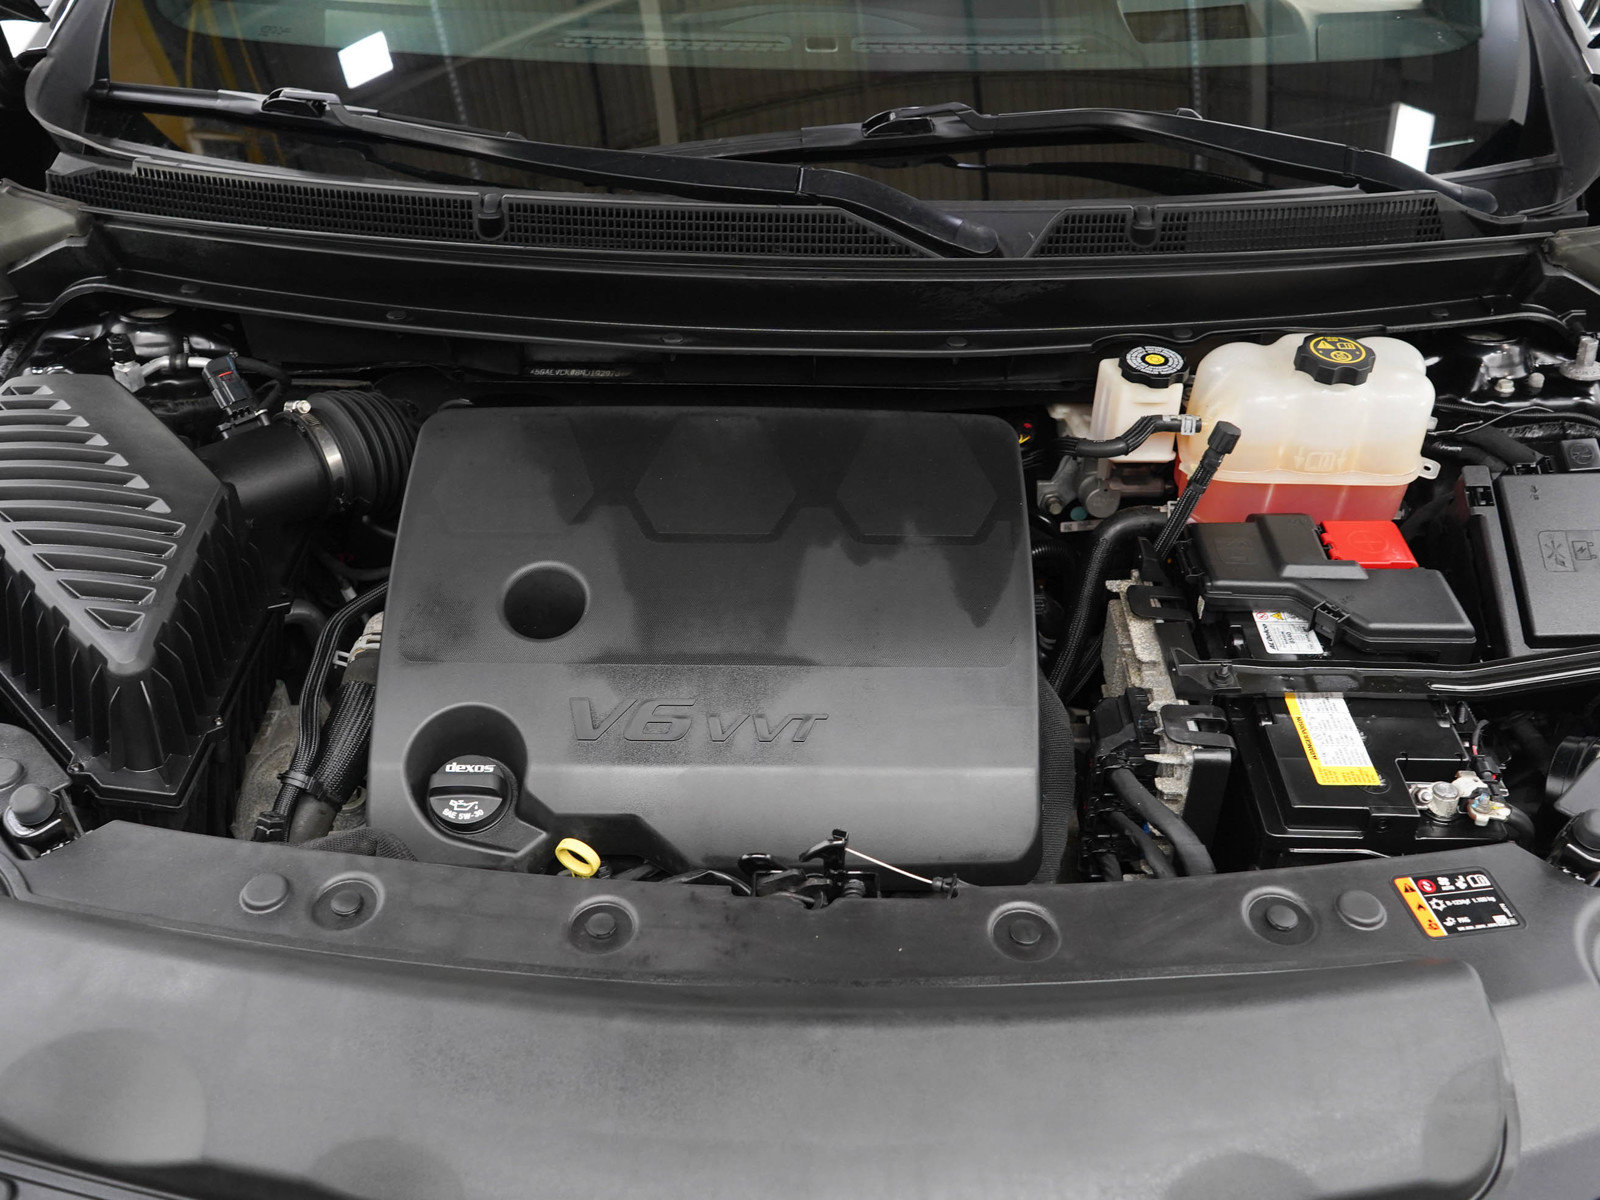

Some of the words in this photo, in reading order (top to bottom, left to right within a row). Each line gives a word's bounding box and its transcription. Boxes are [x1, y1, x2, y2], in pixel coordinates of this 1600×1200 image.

[568, 697, 698, 742] V6
[706, 713, 829, 743] VVT
[445, 762, 496, 773] dexos
[442, 808, 458, 819] SAE
[458, 809, 484, 820] 5W-30
